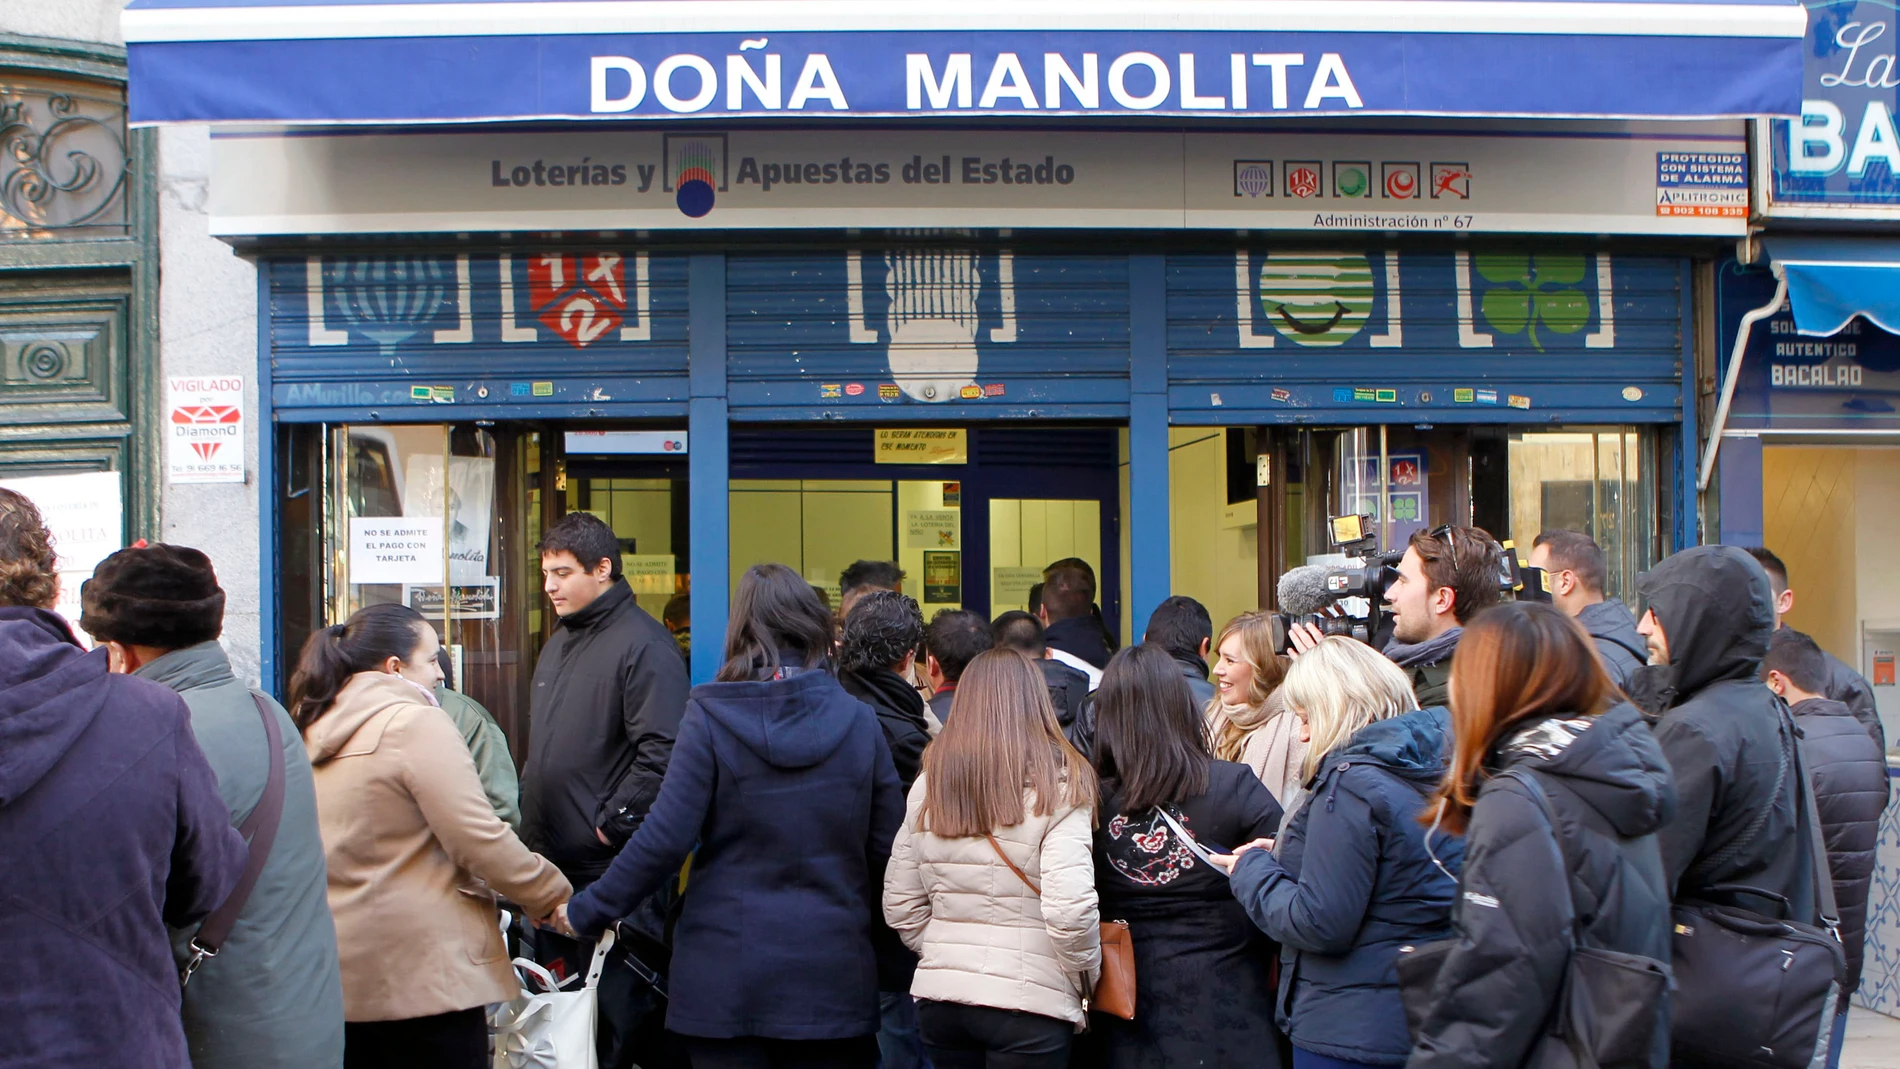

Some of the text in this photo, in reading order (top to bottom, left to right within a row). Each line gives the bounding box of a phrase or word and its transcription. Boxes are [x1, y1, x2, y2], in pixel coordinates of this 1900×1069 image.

[590, 37, 1364, 114] DOÑA MANOLITA
[1661, 153, 1742, 163] PROTEGIDO
[491, 157, 655, 192] Loterías y
[736, 155, 1075, 191] Apuestas del Estado
[1660, 164, 1743, 174] CON SISTEMA
[1660, 174, 1743, 184] DE ALARMA
[1660, 189, 1745, 204] APLITRONIC
[1673, 207, 1695, 215] 902
[1313, 214, 1428, 229] Administración
[1454, 215, 1473, 229] 67
[1776, 342, 1857, 357] AUTENTICO
[1771, 363, 1862, 386] BACALAO
[170, 379, 242, 393] VIGILADO
[364, 529, 428, 537] NO SE ADMITE
[379, 542, 404, 550] PAGO
